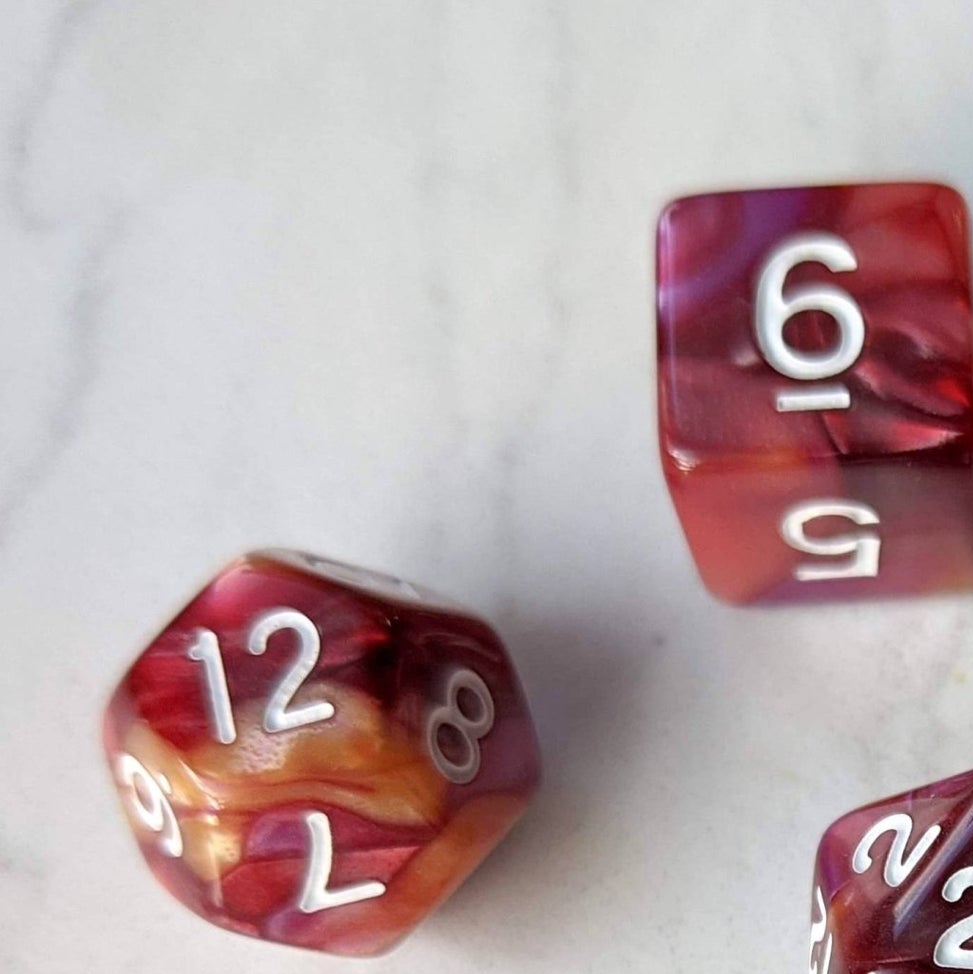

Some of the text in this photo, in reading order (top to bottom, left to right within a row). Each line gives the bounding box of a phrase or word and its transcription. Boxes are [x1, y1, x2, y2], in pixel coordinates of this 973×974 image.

[756, 233, 865, 412] 6
[781, 502, 881, 580] 5
[189, 606, 335, 745] 12
[427, 668, 495, 784] 8
[300, 812, 386, 914] 7
[852, 813, 941, 888] 2
